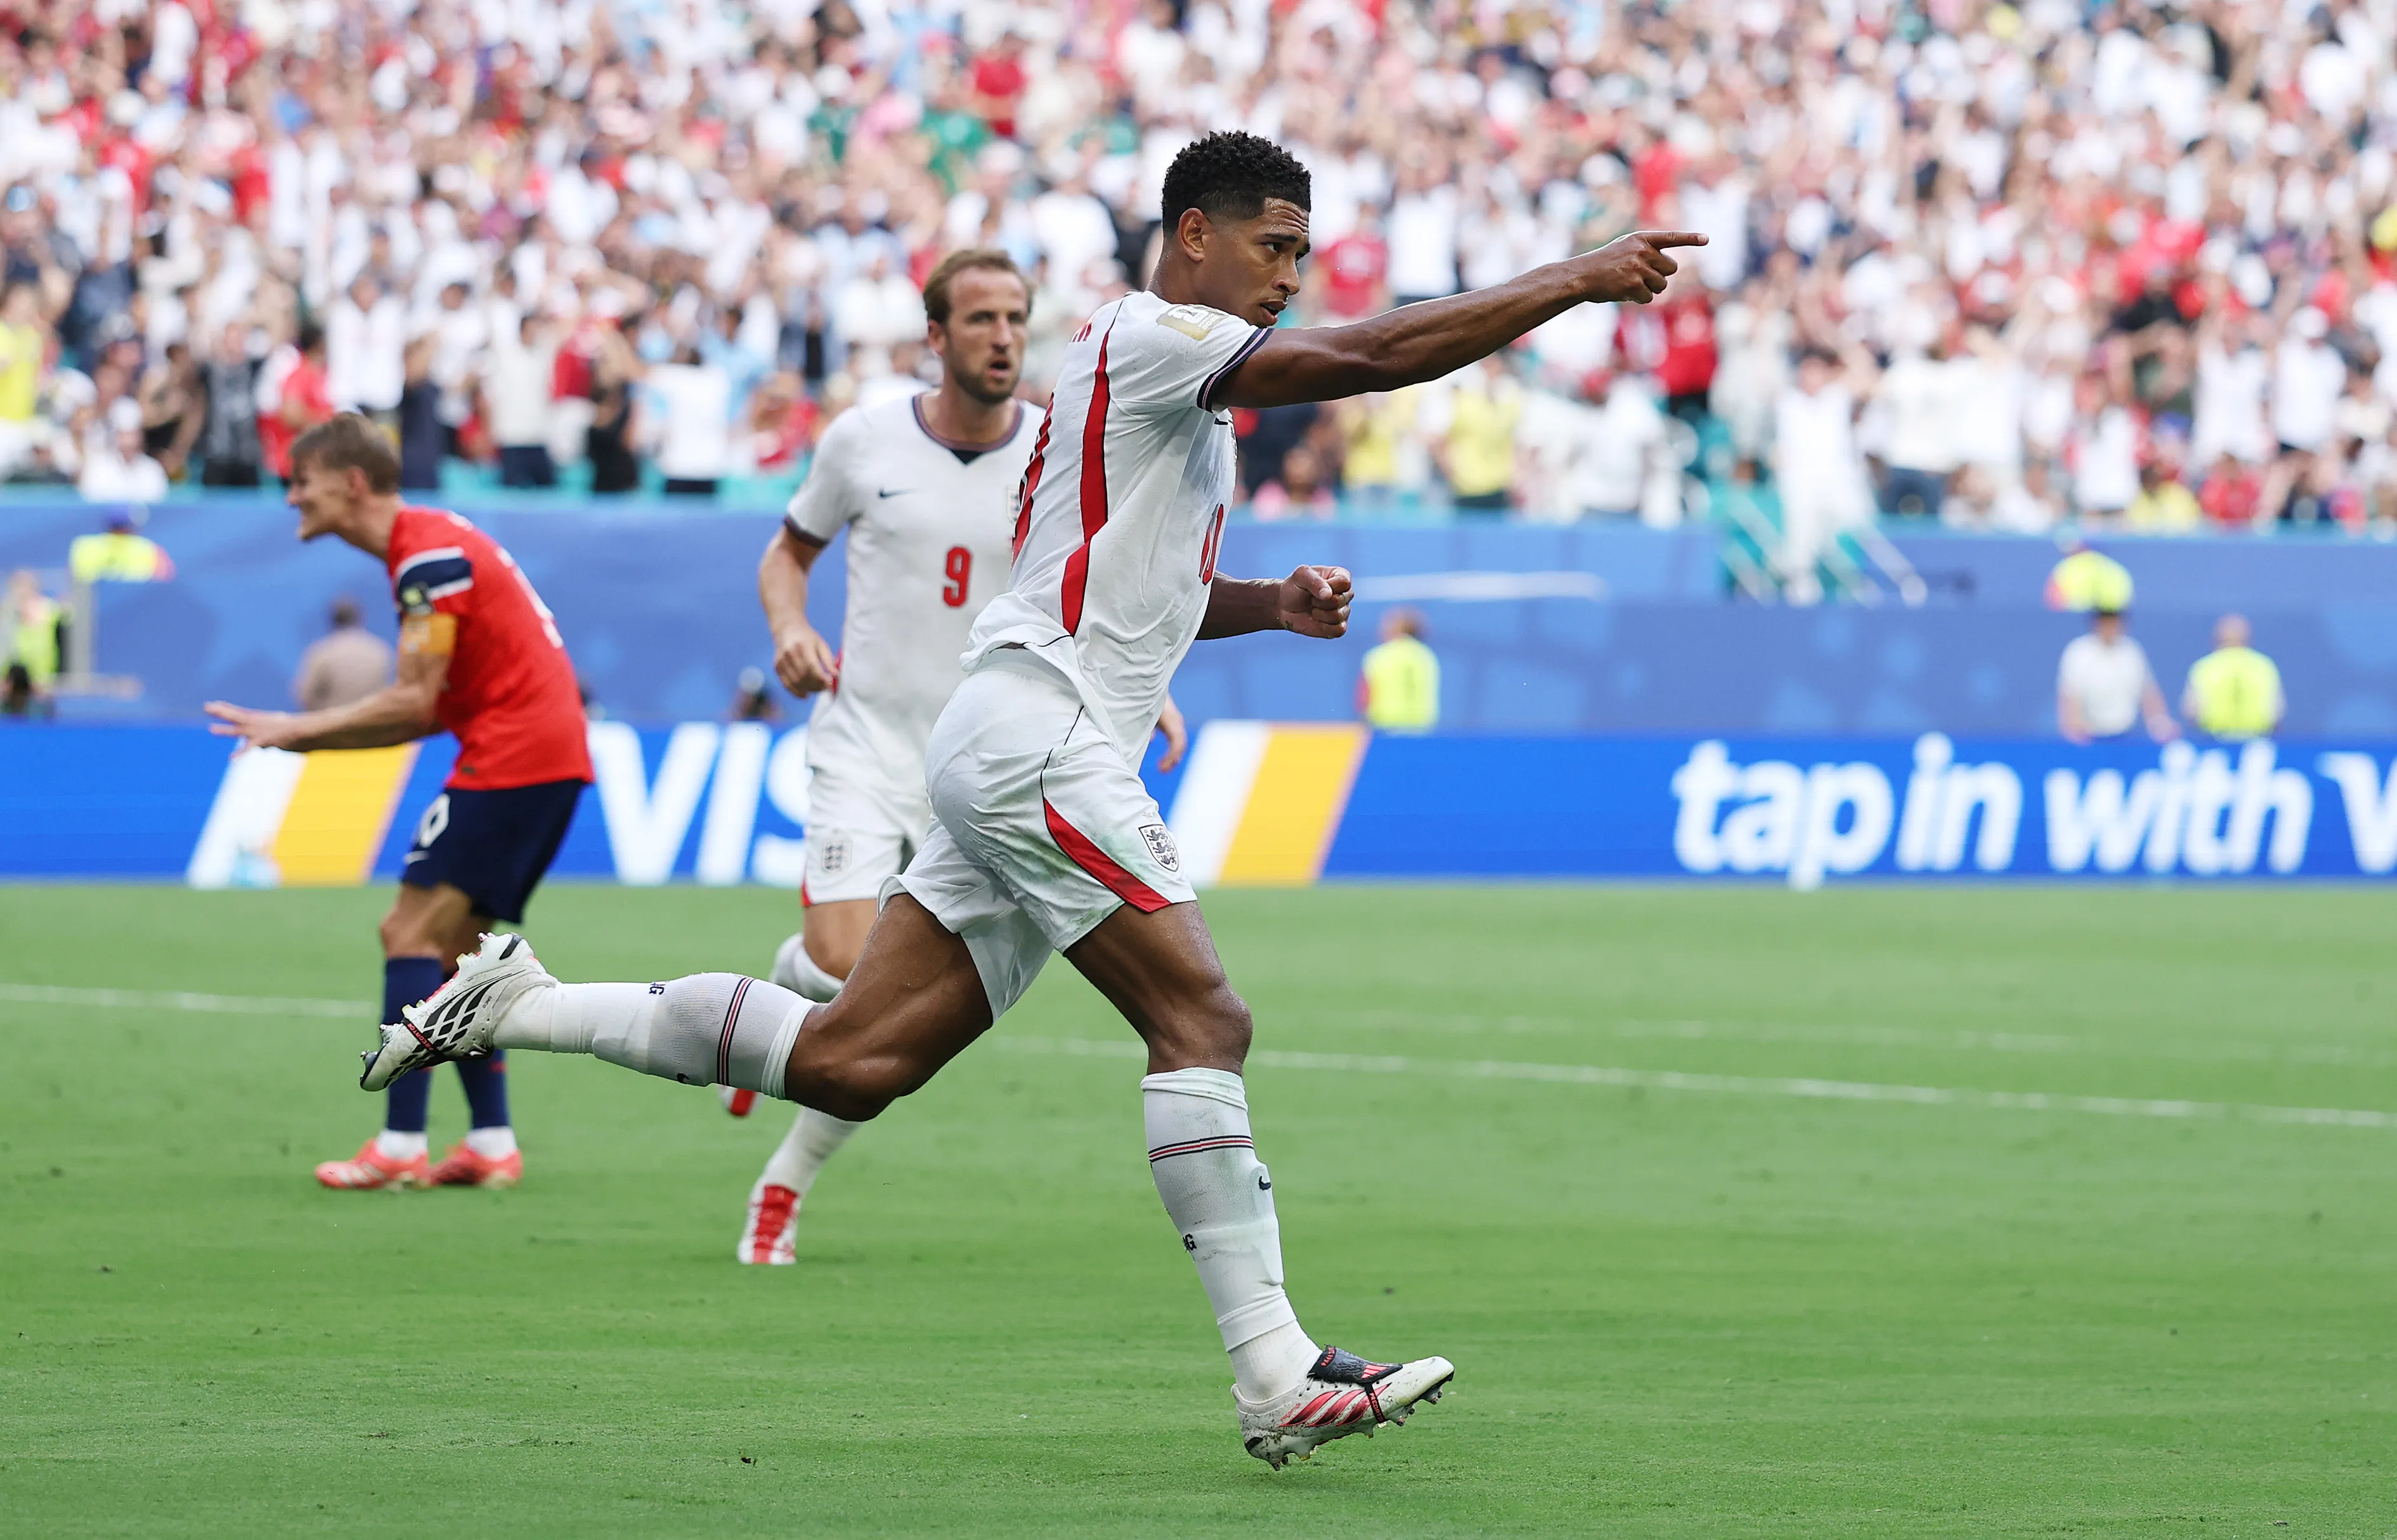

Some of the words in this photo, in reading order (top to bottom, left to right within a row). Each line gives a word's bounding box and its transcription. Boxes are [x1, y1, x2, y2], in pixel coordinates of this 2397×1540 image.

[942, 545, 971, 607] 9
[1672, 739, 1893, 891] tap
[1896, 732, 2024, 872] in
[2043, 737, 2315, 875] with
